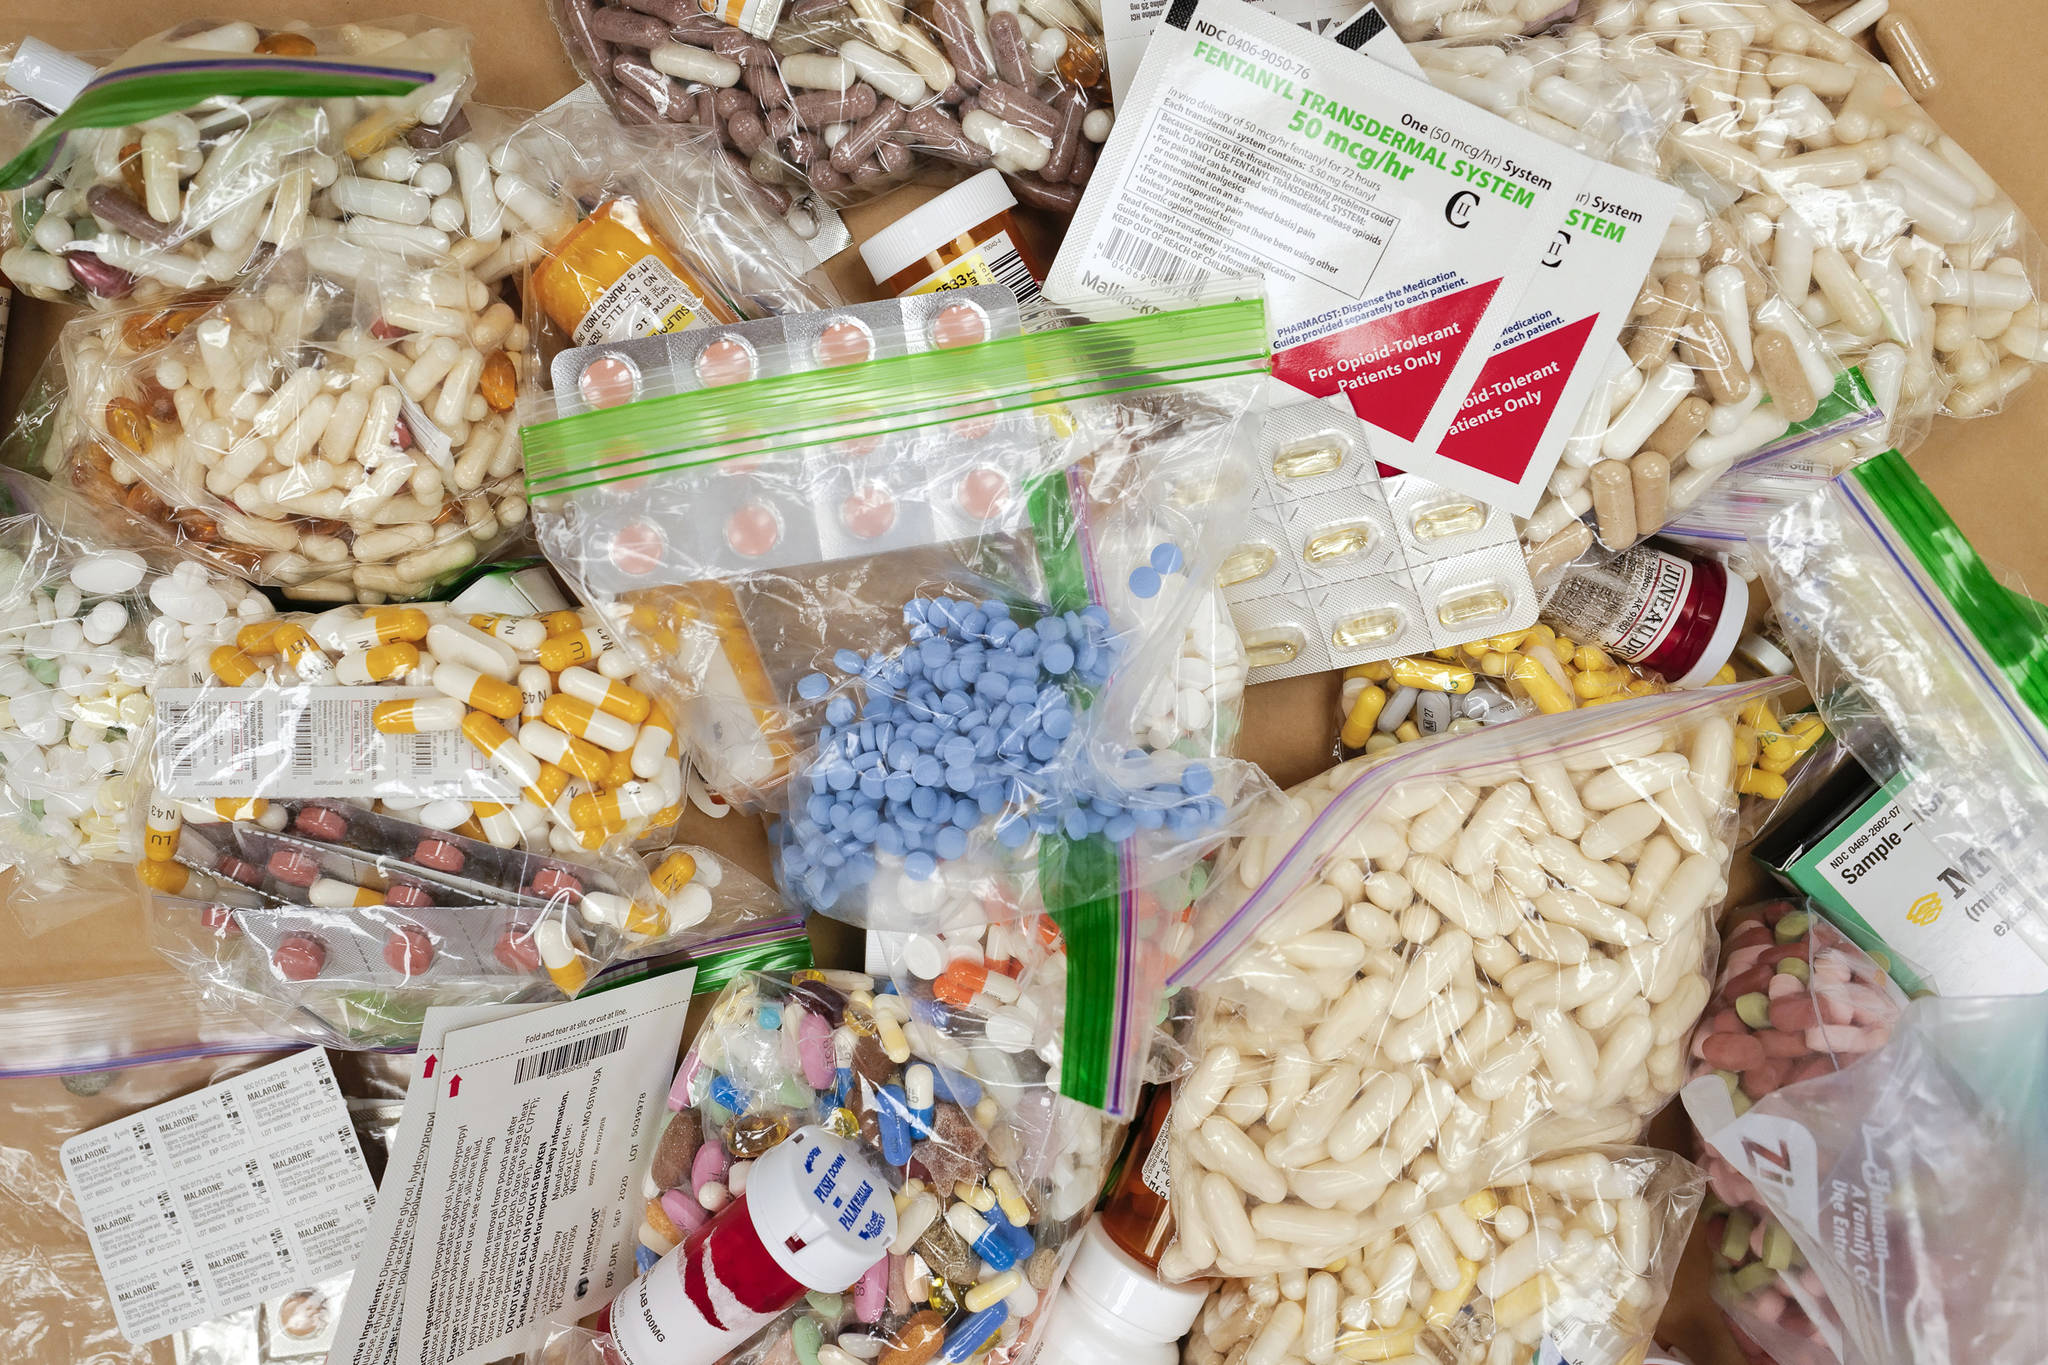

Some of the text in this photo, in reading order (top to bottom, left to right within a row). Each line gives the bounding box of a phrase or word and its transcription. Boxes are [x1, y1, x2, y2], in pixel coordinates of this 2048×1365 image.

[1194, 19, 1311, 80] NDC 0406-9050-76
[1192, 40, 1535, 209] FENTANYL TRANSDERMAL SYSTEM
[1287, 109, 1415, 181] 50 mcg/hr
[1400, 112, 1552, 191] One (50 mcg/hr) System
[1153, 145, 1245, 194] or non-opioid analgesics
[1156, 133, 1382, 246] For pain that can be treated with immediate-release opioids
[1160, 111, 1395, 227] Because serious or life-threatening breathing problems could
[1181, 132, 1196, 145] DO
[1194, 139, 1214, 154] NOT
[1213, 147, 1230, 162] USE
[1229, 155, 1270, 180] FENTANYL
[1271, 175, 1330, 210] TRANSDERMAL
[1330, 203, 1366, 226] SYSTEM:
[1111, 211, 1133, 227] KEEP
[1132, 222, 1152, 236] OUT
[1150, 230, 1163, 241] OF
[1162, 235, 1191, 255] REACH
[1190, 249, 1203, 261] OF
[1116, 202, 1140, 219] Guide
[1139, 213, 1153, 225] for
[1152, 218, 1193, 245] important
[1192, 240, 1218, 257] safety
[1120, 192, 1296, 282] Read fentanyl transdermal system Medication
[1592, 196, 1643, 223] System
[1272, 277, 1469, 349] Guide provided separately to each patient.
[1276, 270, 1457, 338] PHARMACIST: Dispense the Medication
[1492, 316, 1565, 351] o each patient.
[1307, 321, 1461, 382] For Opioid-Tolerant
[1336, 349, 1441, 395] Patients Only
[1461, 360, 1560, 408] oid-Tolerant
[1503, 389, 1541, 412] Only
[1631, 597, 1644, 611] AK
[1639, 564, 1681, 639] JUNEAU
[1830, 851, 1851, 870] NDC
[1850, 805, 1901, 855] 0469-2602-07
[1841, 832, 1902, 885] Sample
[568, 1066, 603, 1195] Webster Groves, MO 63119 USA
[807, 1146, 822, 1163] OPEN
[550, 1122, 573, 1201] Manufactured for:
[559, 1147, 576, 1198] SpecGx LLC
[813, 1173, 836, 1204] PUSH
[827, 1153, 847, 1179] DOWN
[504, 1140, 547, 1334] DO NOT USE IF SEAL ON POUCH IS BROKEN
[515, 1090, 570, 1329] See Medication Guide for important safety information.
[838, 1196, 861, 1232] PALM
[865, 1210, 879, 1231] CLOSE
[870, 1213, 886, 1239] TIGHTLY
[640, 1285, 666, 1343] TAB 500MG
